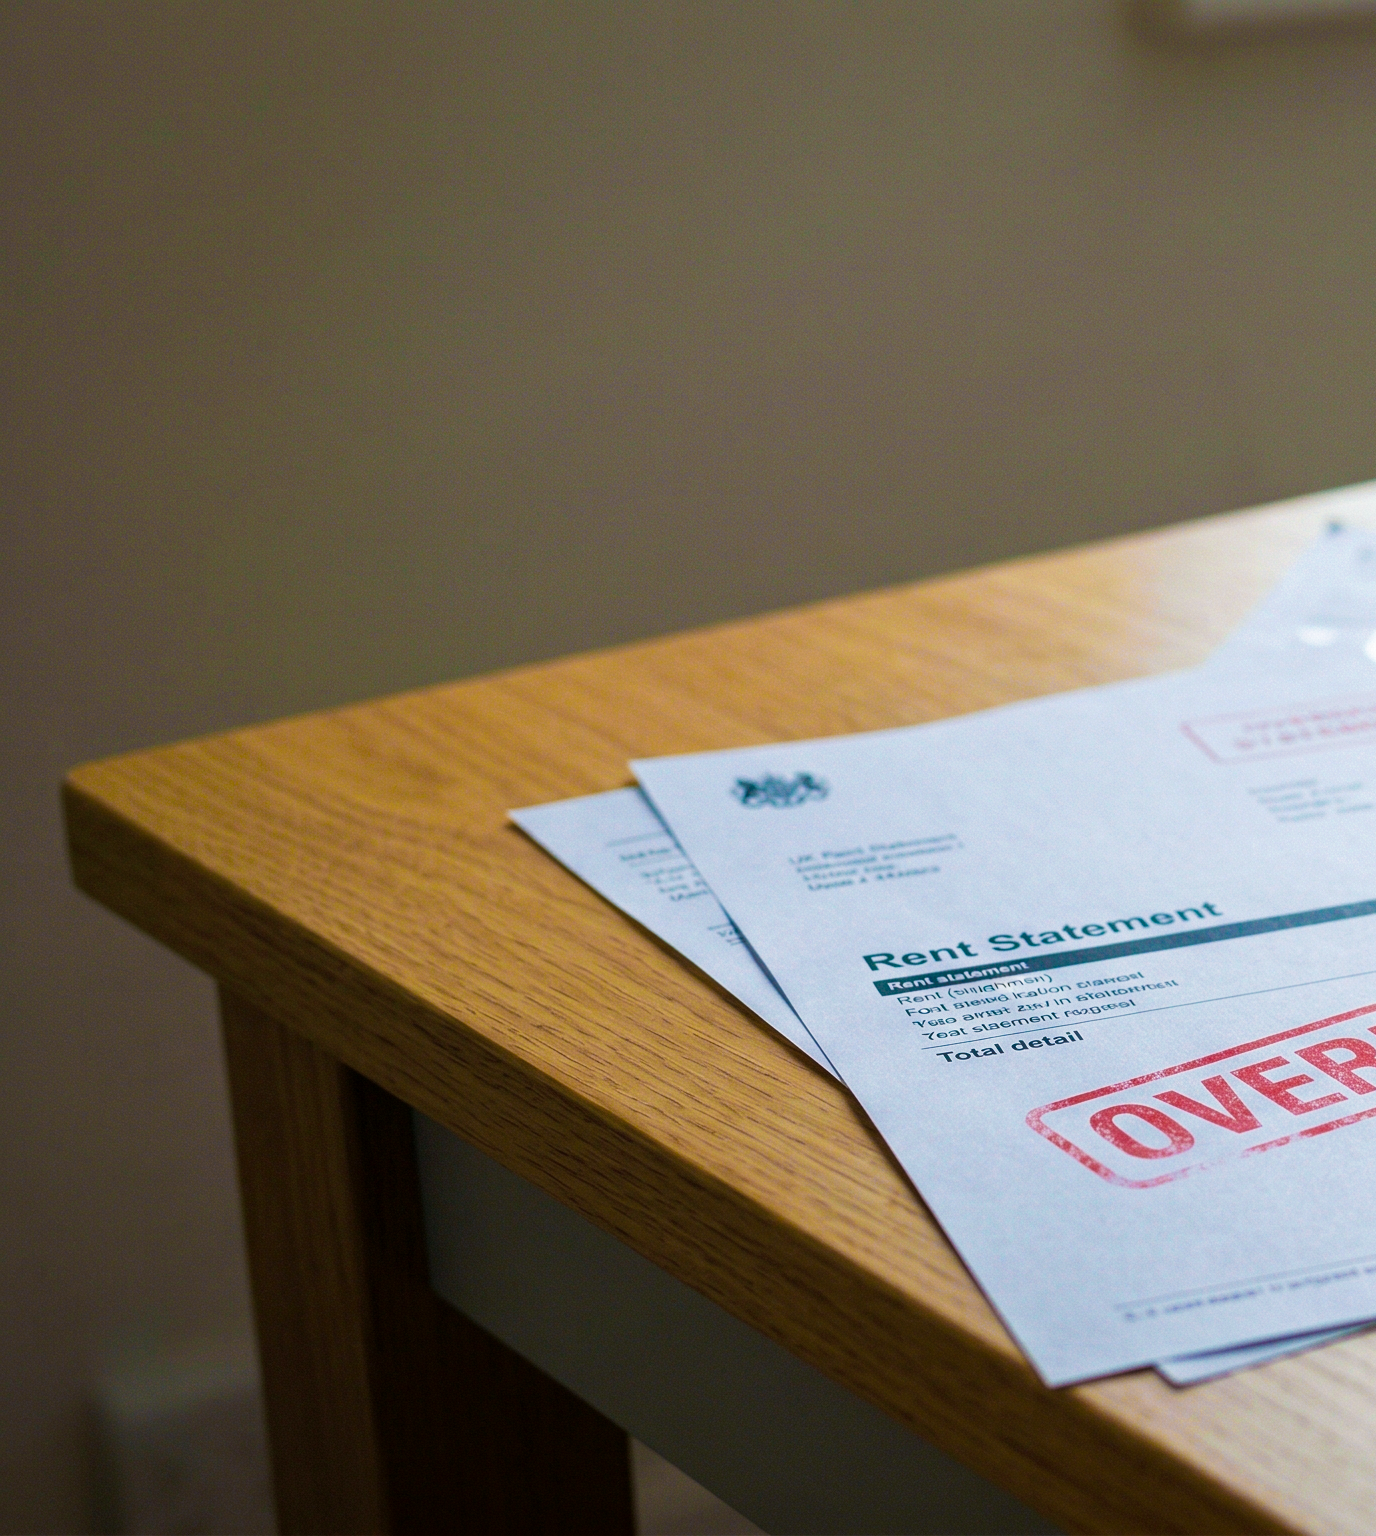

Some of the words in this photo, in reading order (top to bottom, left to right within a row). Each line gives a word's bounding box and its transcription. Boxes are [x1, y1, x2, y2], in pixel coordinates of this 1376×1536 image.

[862, 940, 978, 973] Rent
[987, 901, 1224, 953] Statement
[887, 975, 935, 992] Rent
[936, 1043, 1006, 1064] Total
[1010, 1030, 1085, 1053] detail
